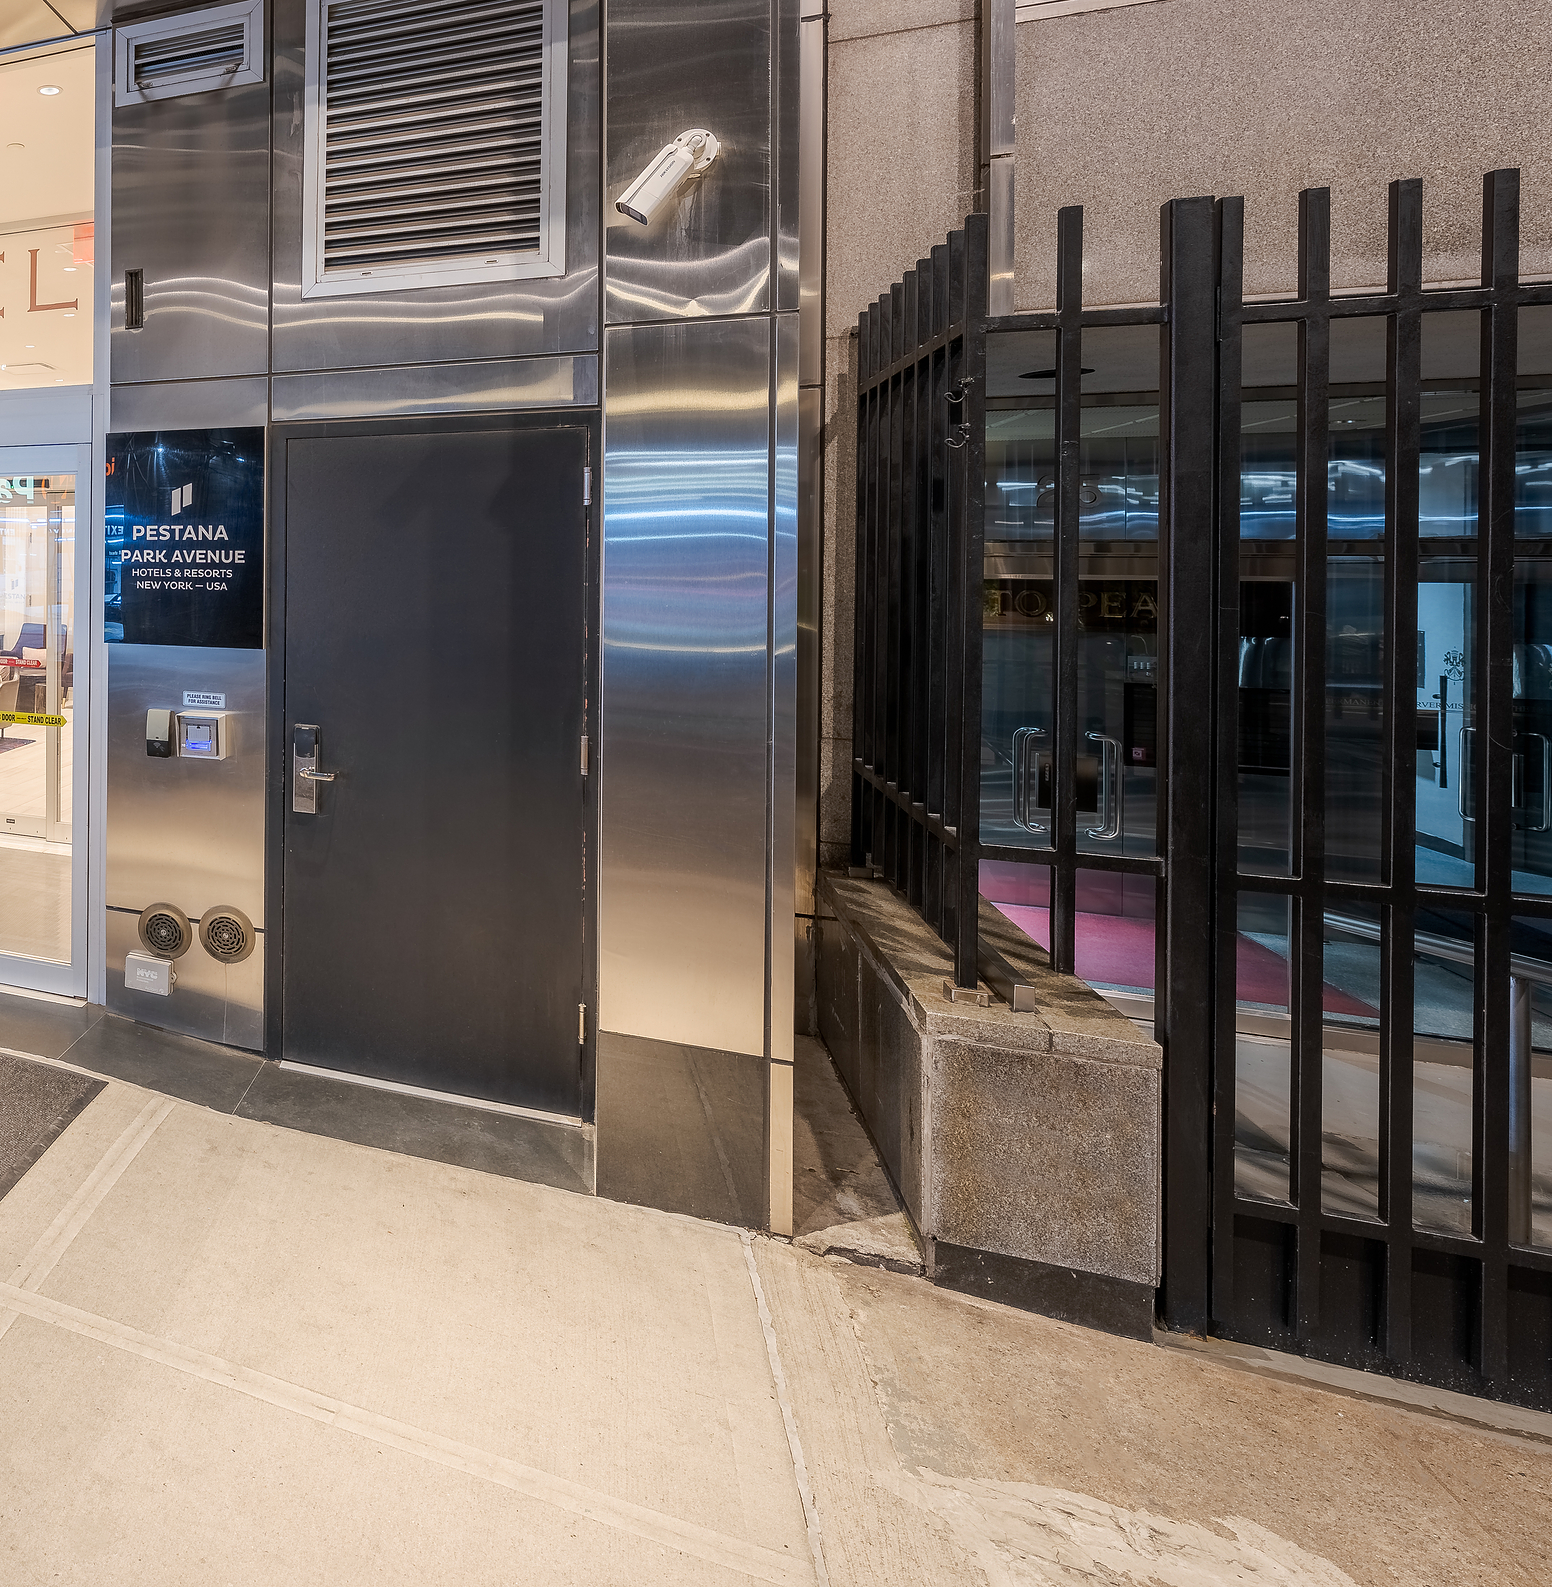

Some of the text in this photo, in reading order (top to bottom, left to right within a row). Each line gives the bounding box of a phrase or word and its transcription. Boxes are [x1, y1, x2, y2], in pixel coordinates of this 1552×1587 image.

[132, 525, 229, 541] PESTANA
[121, 550, 246, 564] PARK AVENUE
[131, 568, 233, 578] HOTELS & RESORTS
[136, 581, 161, 589] NEW
[163, 581, 194, 590] YORK
[206, 582, 228, 591] USA
[1, 713, 16, 722] DOOR
[27, 715, 44, 724] STAND
[44, 717, 62, 725] CLEAR
